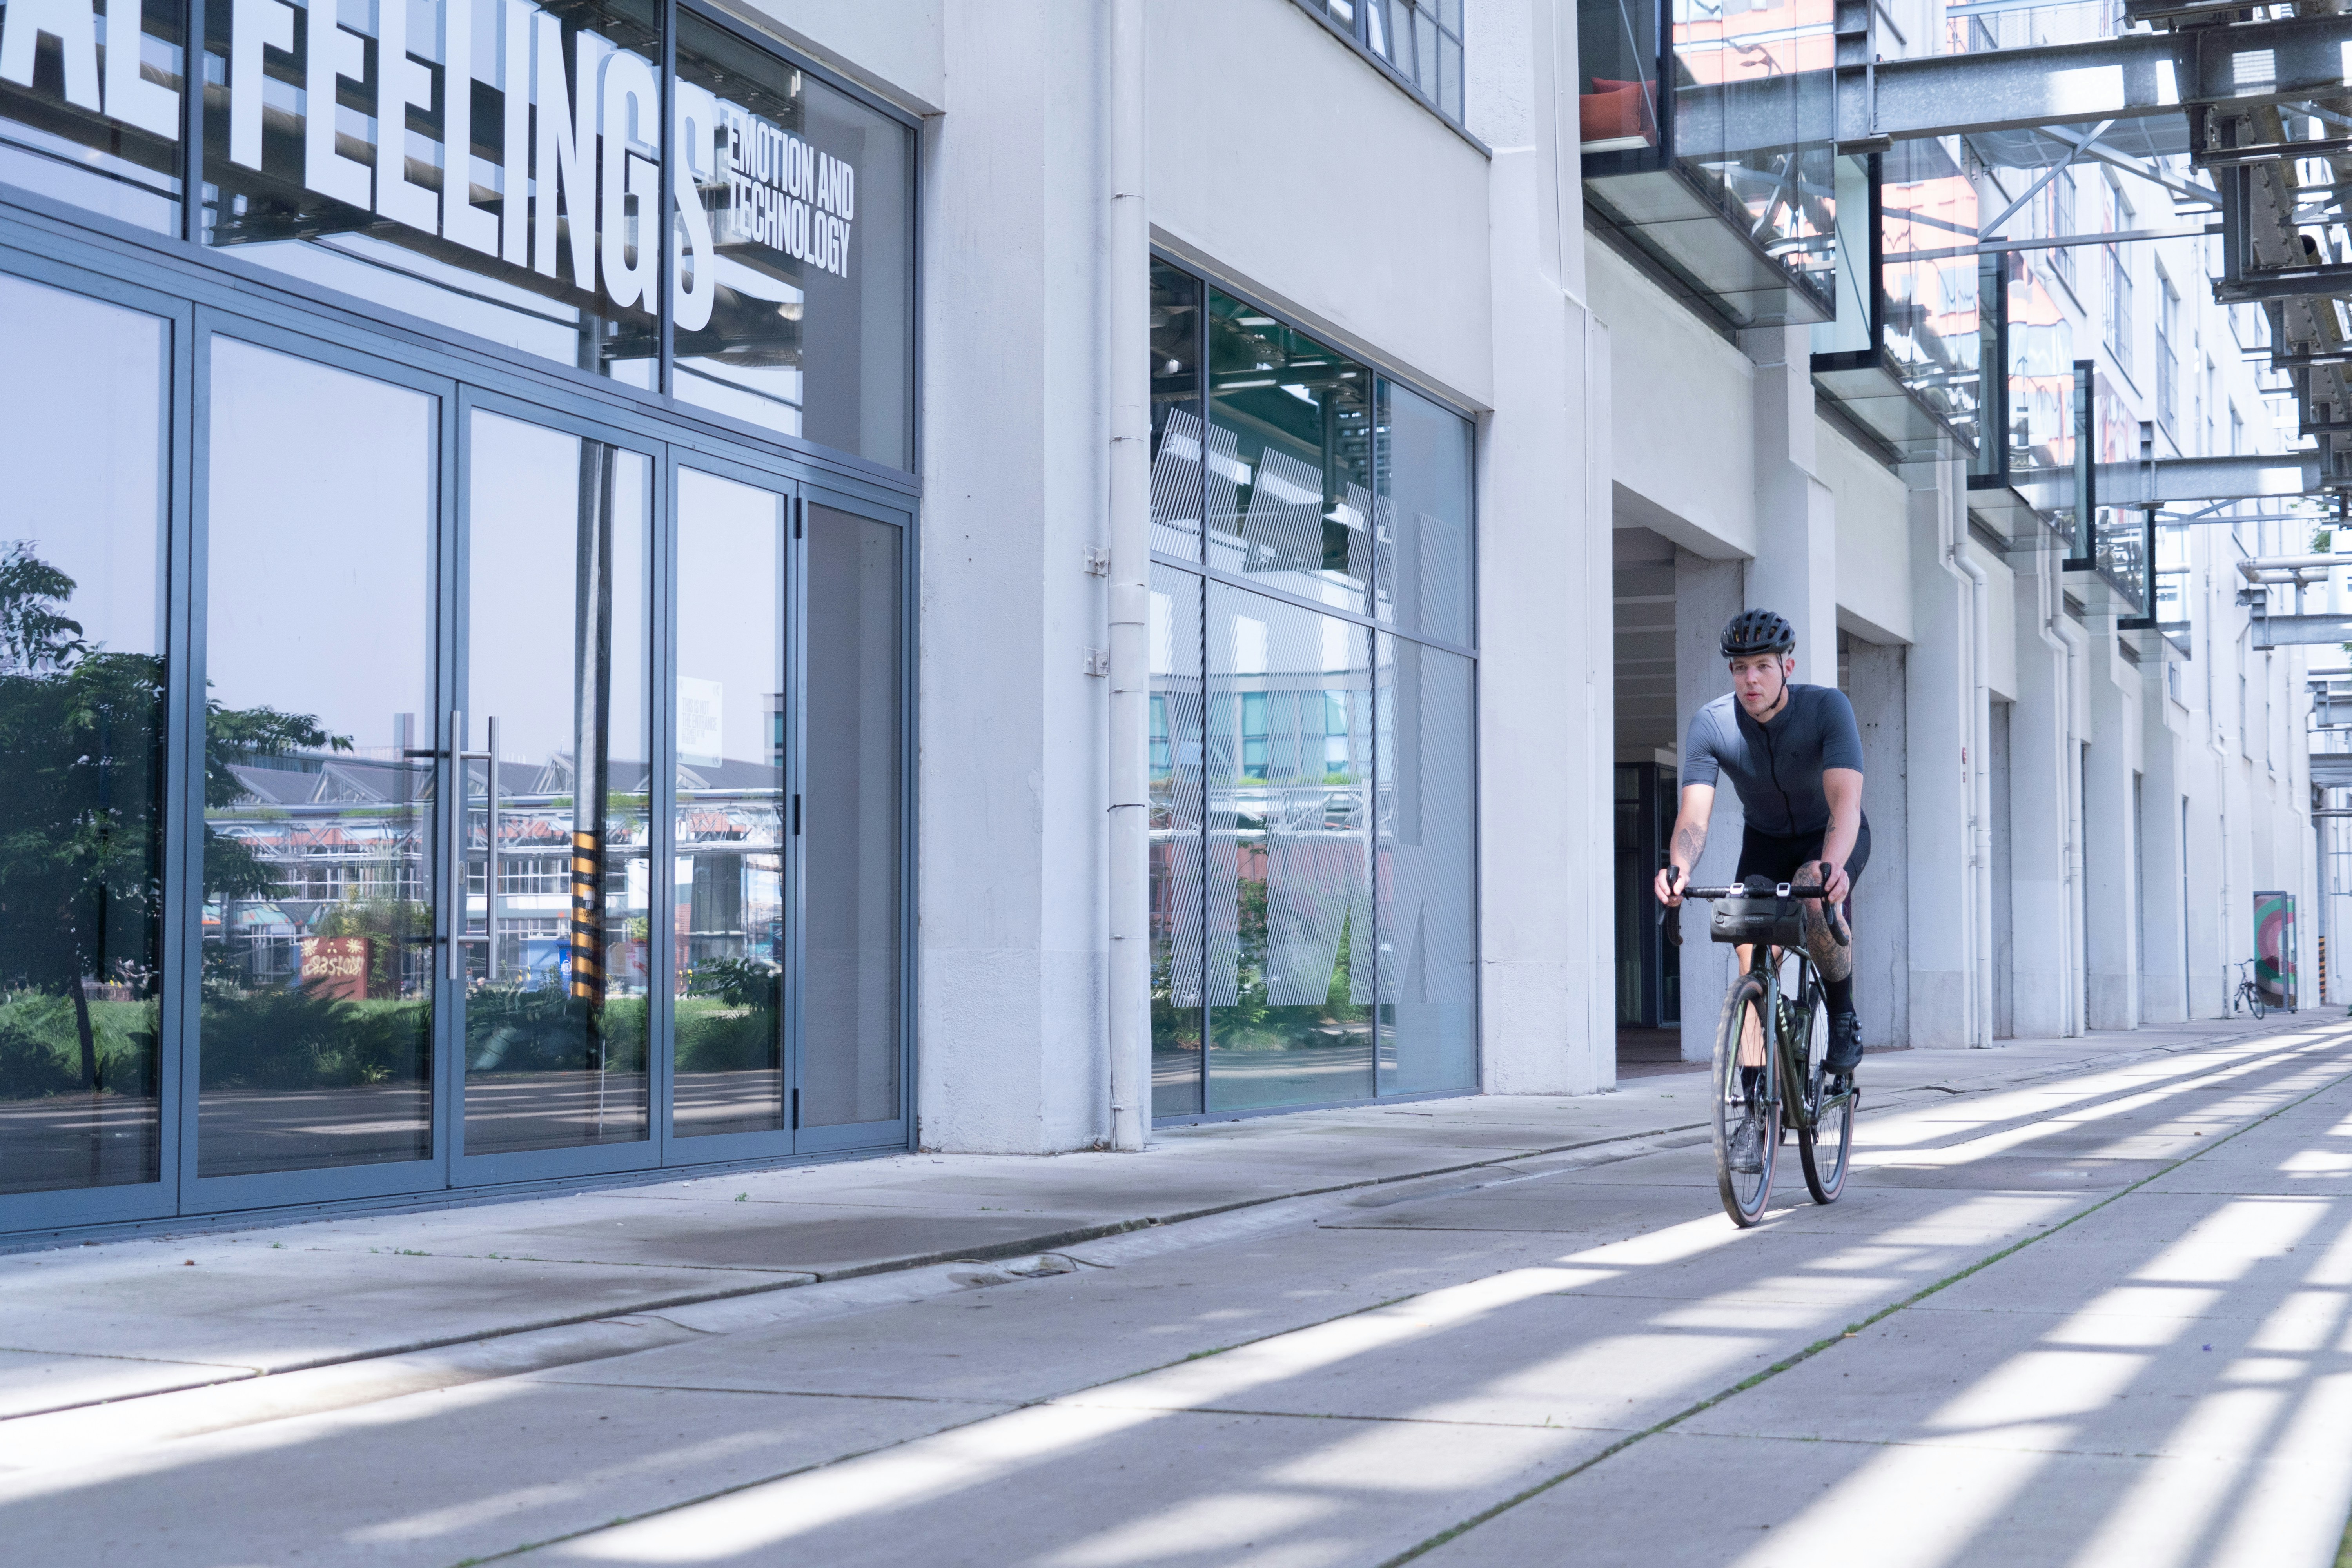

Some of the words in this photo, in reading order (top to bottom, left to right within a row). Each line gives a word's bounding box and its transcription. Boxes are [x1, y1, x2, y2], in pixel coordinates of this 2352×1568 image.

[727, 106, 814, 204] EMOTION
[817, 152, 854, 221] AND
[727, 168, 851, 278] TECHNOLOGY
[682, 697, 693, 713] THIS
[694, 699, 699, 713] IS
[700, 700, 710, 715] NOT
[682, 712, 691, 728] THE
[692, 713, 717, 731] ENTRANCE
